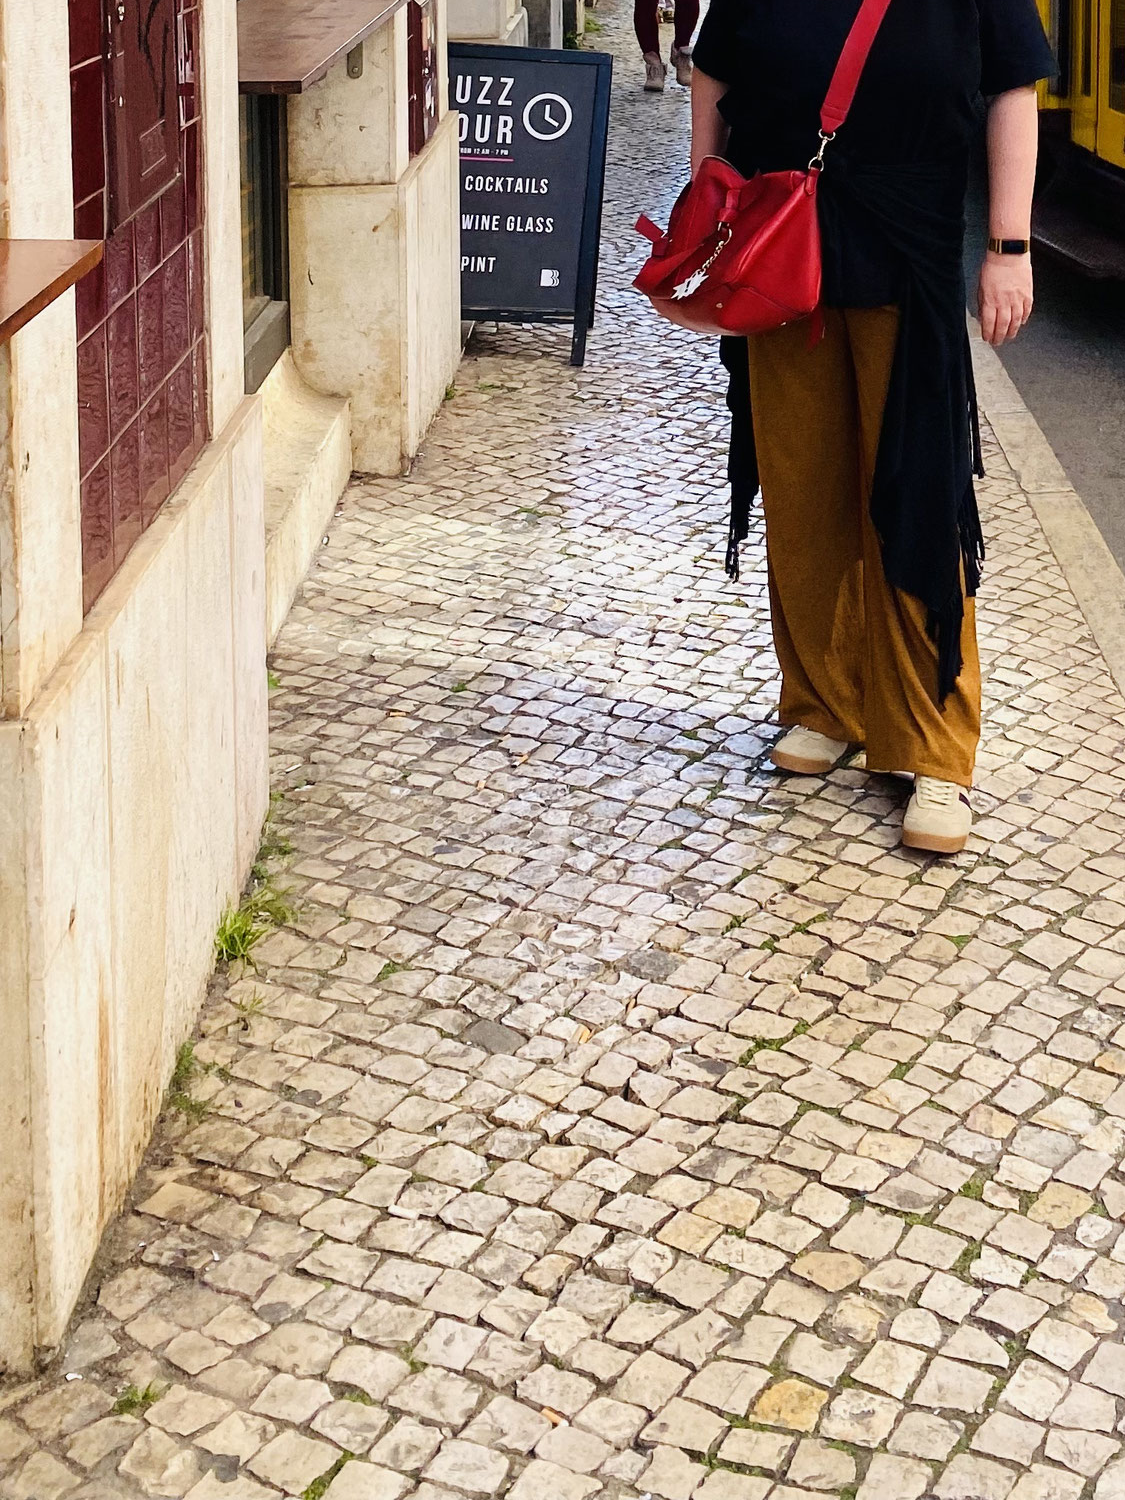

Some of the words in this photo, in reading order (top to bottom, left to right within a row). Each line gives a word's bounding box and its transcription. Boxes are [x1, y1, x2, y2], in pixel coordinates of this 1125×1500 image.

[455, 74, 515, 106] UZZ
[459, 113, 514, 145] OUR
[464, 175, 549, 194] COCKTAILS
[461, 214, 501, 231] WINE
[506, 215, 554, 233] GLASS
[460, 256, 497, 273] PINT
